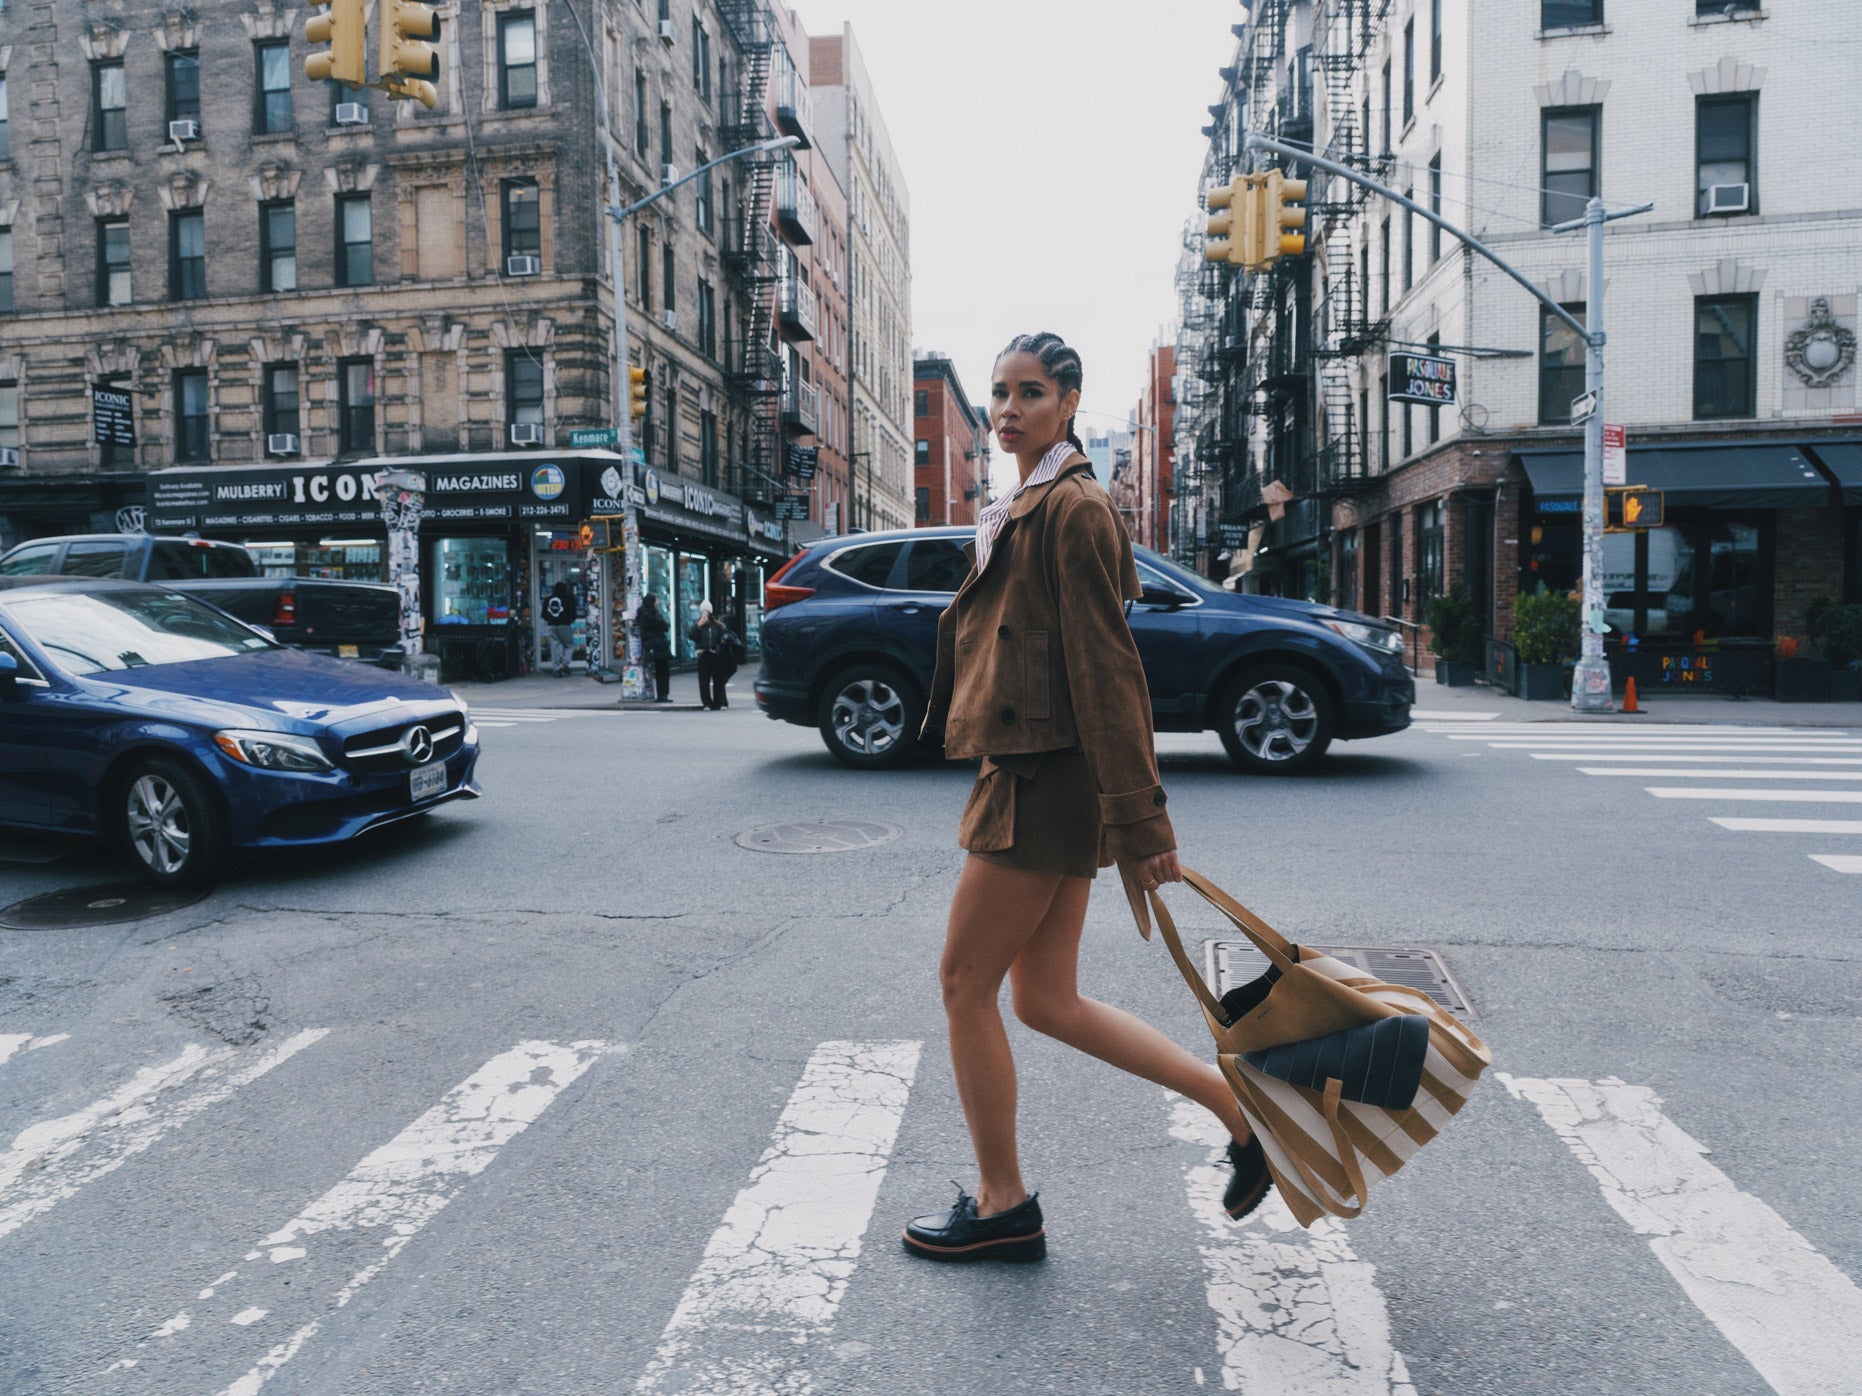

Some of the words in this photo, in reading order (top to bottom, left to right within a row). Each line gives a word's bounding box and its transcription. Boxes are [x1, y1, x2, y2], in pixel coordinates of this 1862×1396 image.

[1406, 379, 1452, 399] JONES
[94, 391, 131, 406] ICONIC
[573, 433, 608, 444] Kenmare
[292, 474, 382, 503] ICON
[436, 475, 517, 491] MAGAZINES
[217, 484, 282, 499] MULBERRY
[304, 512, 333, 522] TOBACCO
[440, 507, 475, 517] GROCERIES
[1661, 671, 1712, 682] JONES
